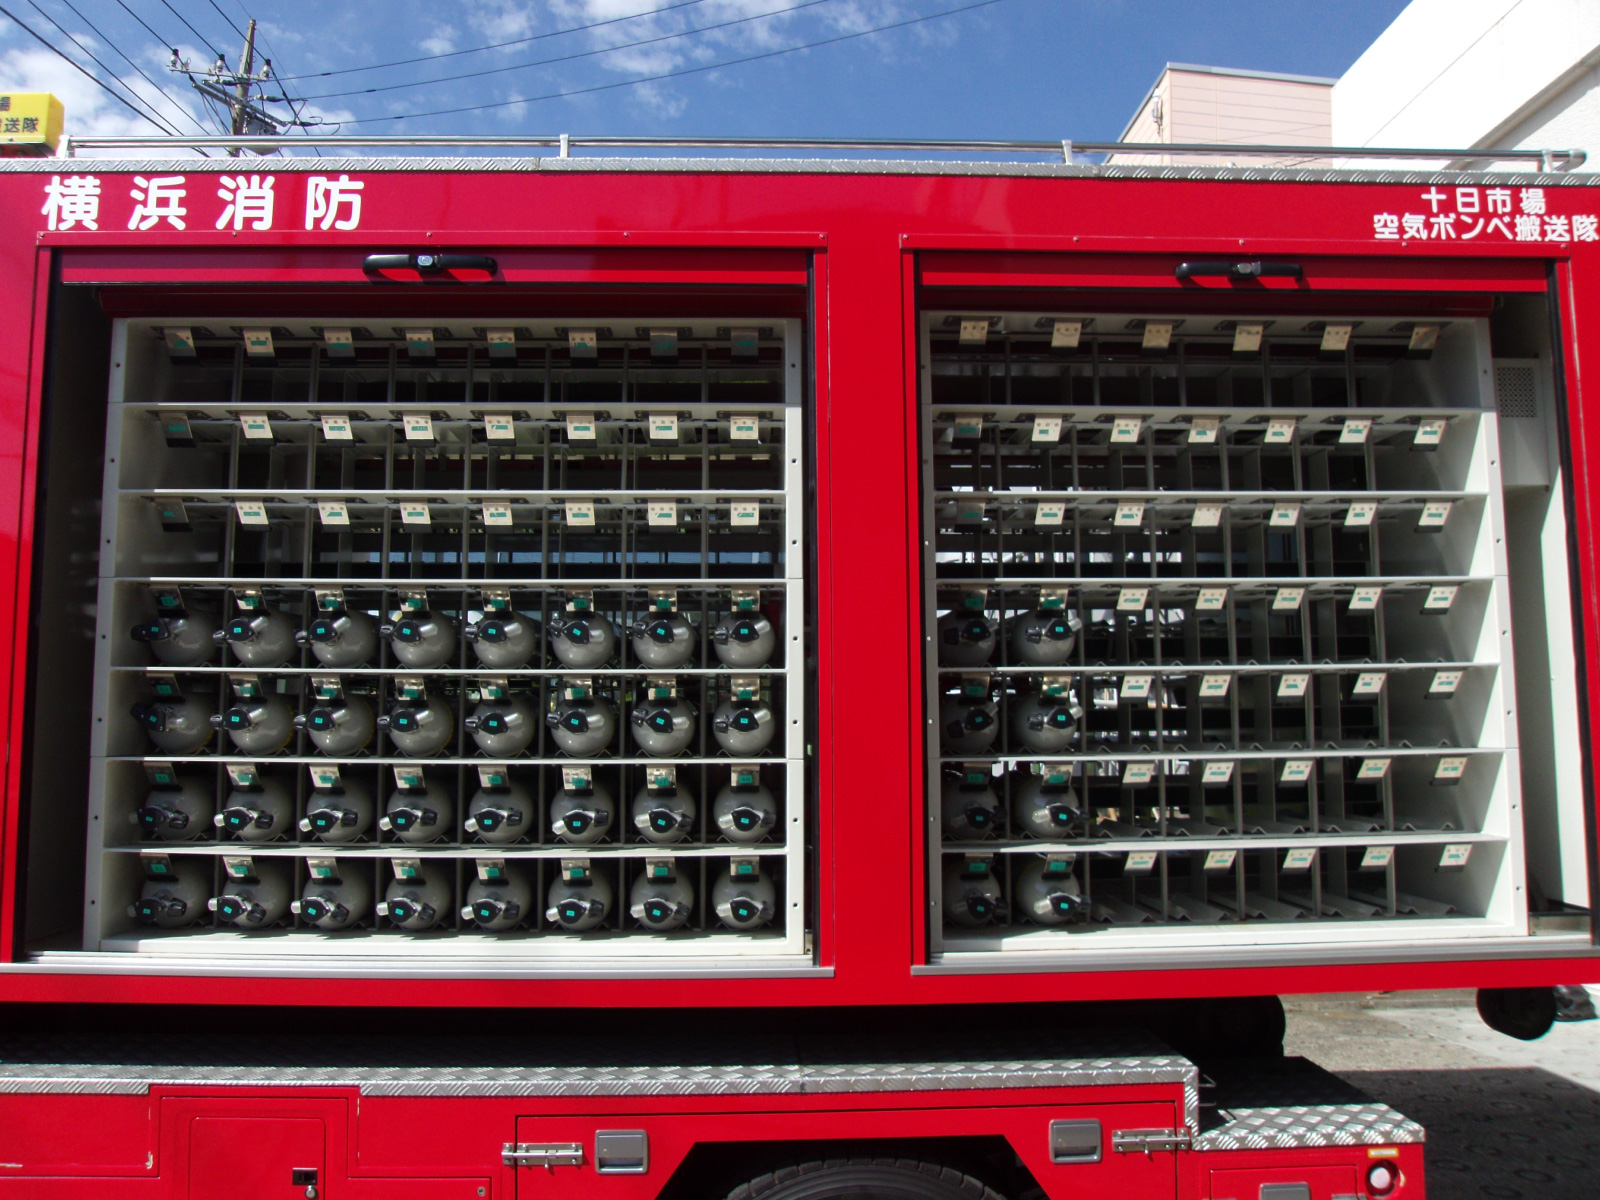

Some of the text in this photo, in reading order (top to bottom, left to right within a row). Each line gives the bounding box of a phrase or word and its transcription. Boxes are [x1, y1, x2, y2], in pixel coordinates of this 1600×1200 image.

[0, 117, 39, 133] 送隊
[41, 175, 365, 232] 横浜消防
[1421, 186, 1546, 214] 十日市場
[1373, 212, 1600, 242] 空気ボンベ搬送隊
